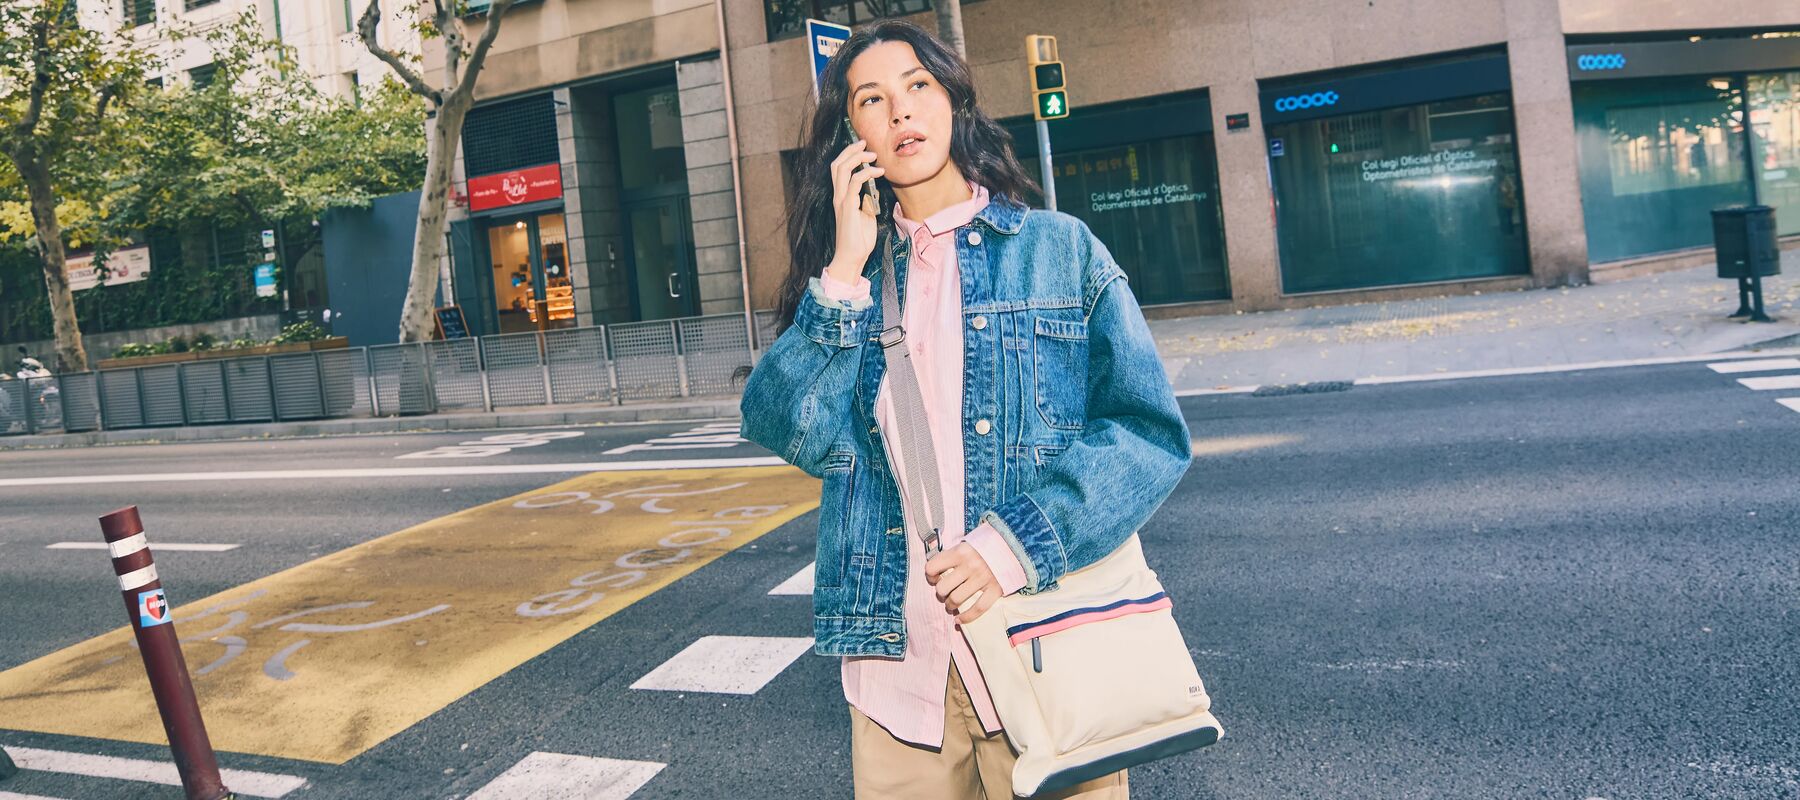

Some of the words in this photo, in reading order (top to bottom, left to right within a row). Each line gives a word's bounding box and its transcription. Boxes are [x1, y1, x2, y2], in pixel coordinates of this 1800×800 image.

[1362, 166, 1431, 182] Optometristes
[1432, 164, 1446, 174] de
[1447, 158, 1498, 172] Catalunya
[1400, 154, 1432, 166] Oficial
[1092, 198, 1150, 212] Optometristes
[1152, 196, 1163, 205] de
[1164, 192, 1207, 204] Catalunya
[1124, 187, 1151, 198] Oficial
[394, 431, 585, 460] BUS
[515, 505, 788, 616] escola
